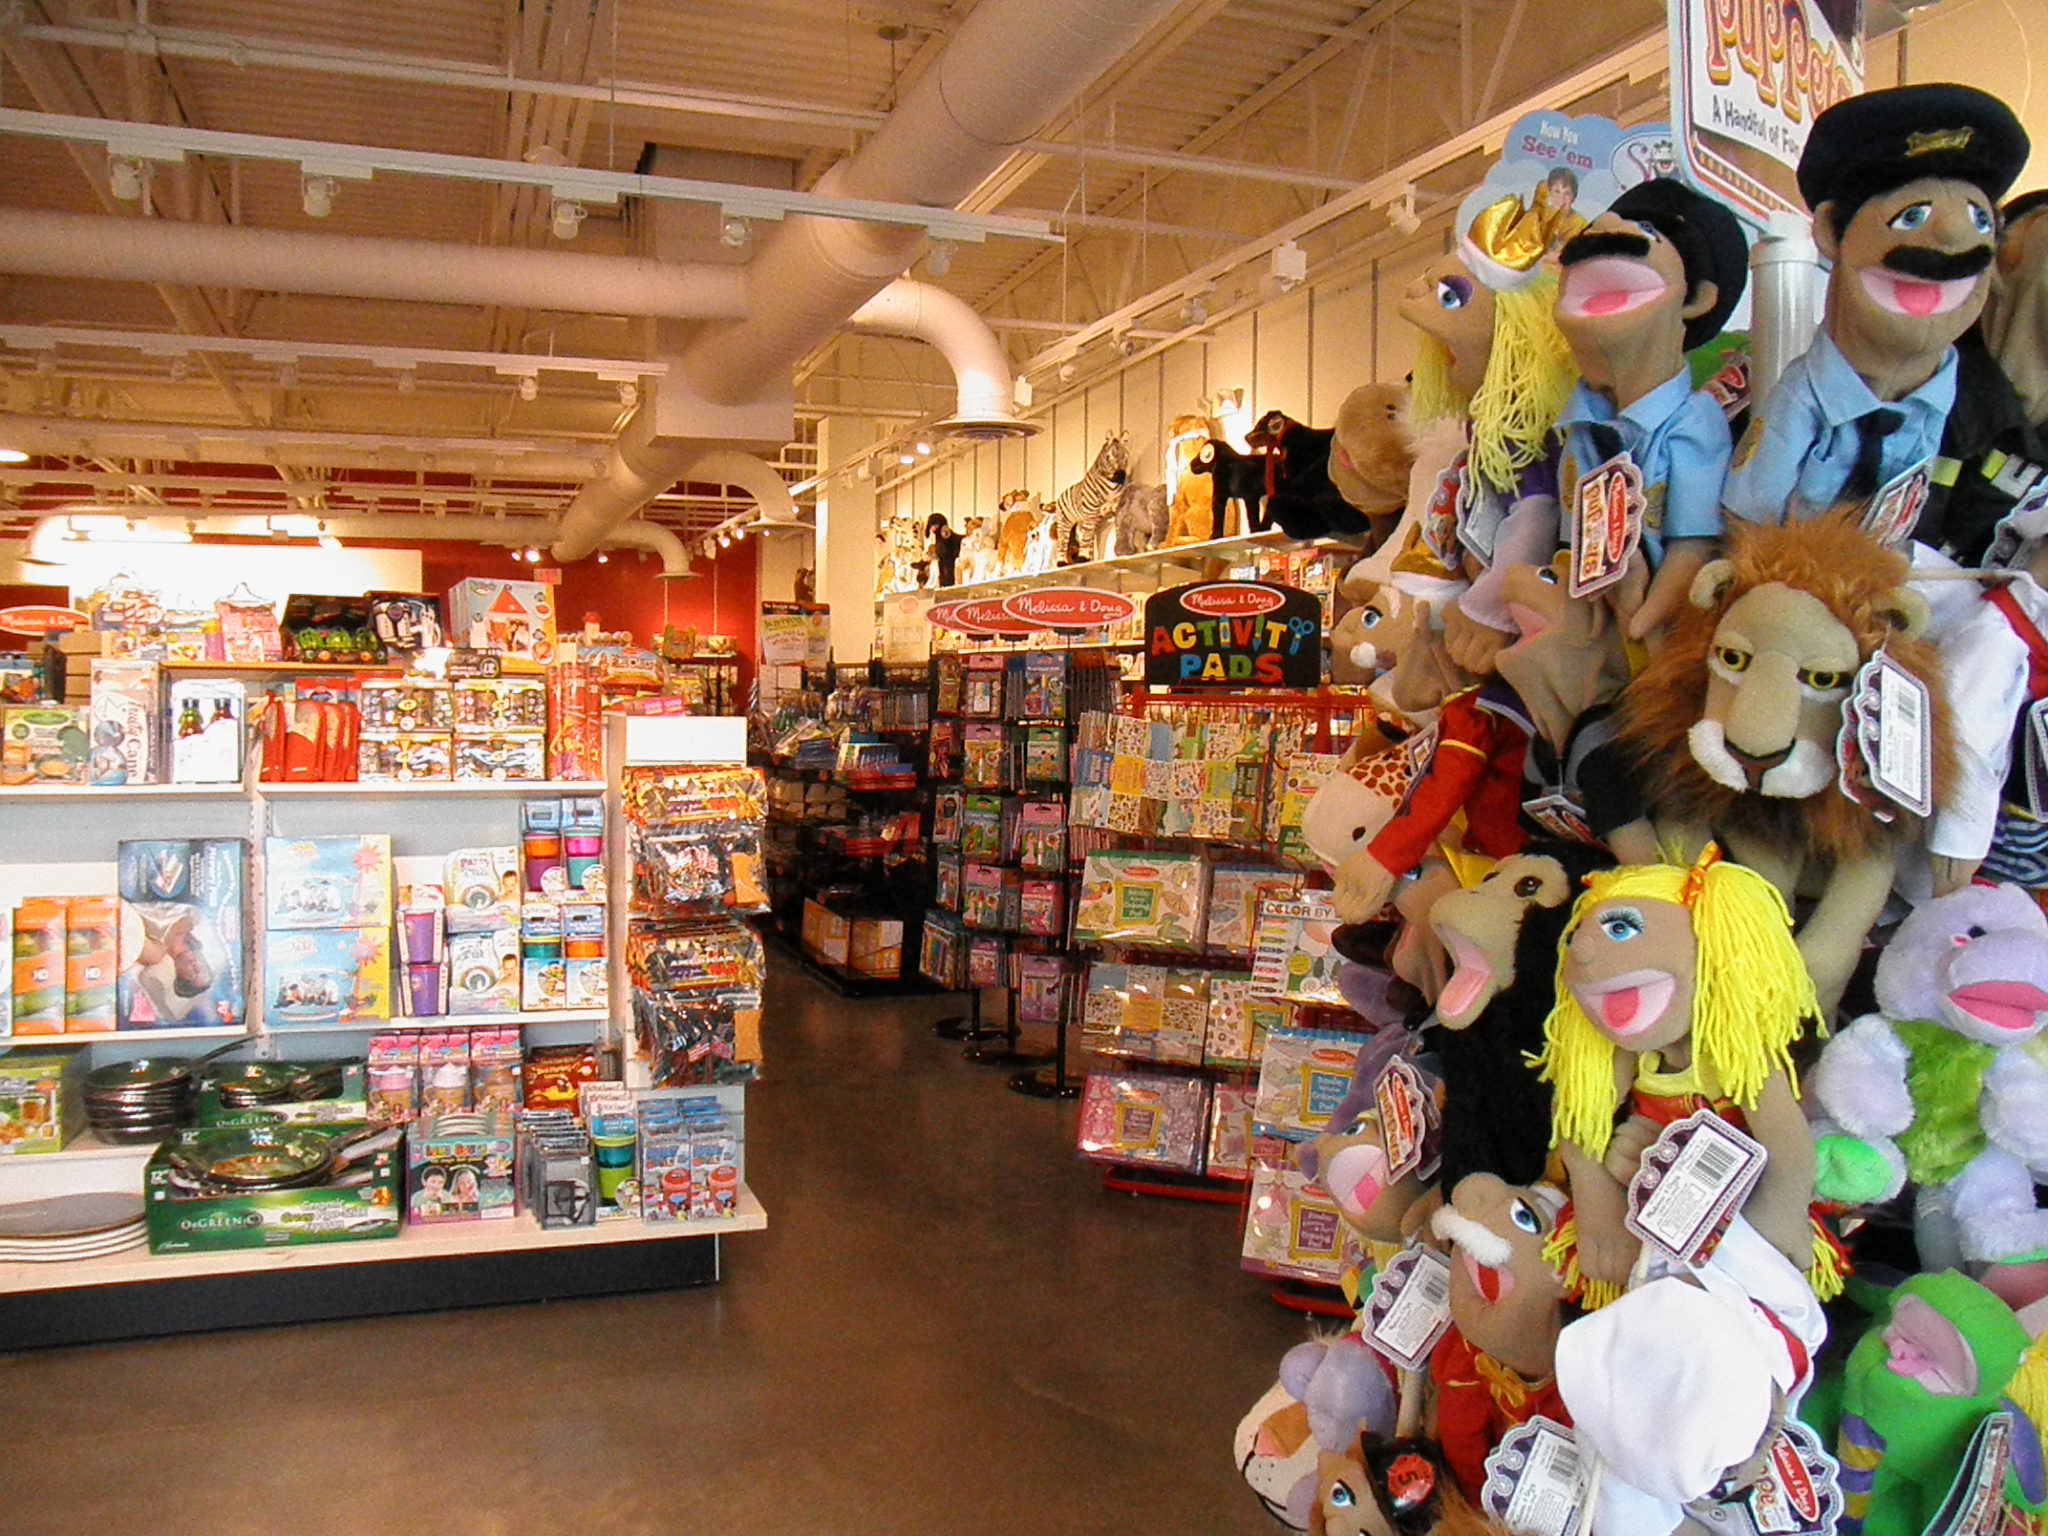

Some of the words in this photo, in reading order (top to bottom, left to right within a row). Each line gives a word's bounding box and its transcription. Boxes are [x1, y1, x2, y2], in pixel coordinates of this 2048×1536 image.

[1540, 120, 1560, 139] Now
[1562, 126, 1579, 144] You
[1712, 94, 1722, 123] A
[1724, 98, 1767, 141] Handful
[1769, 125, 1779, 147] of
[1522, 135, 1558, 159] See
[1016, 595, 1075, 616] Melissa
[1079, 599, 1085, 612] &
[1089, 599, 1124, 620] Doug
[1191, 592, 1237, 609] Melissa
[1247, 593, 1275, 611] Doug
[1151, 612, 1315, 657] ACTIVITY
[1179, 652, 1285, 686] PADS
[1266, 902, 1311, 916] COLOR
[1314, 908, 1332, 917] BY
